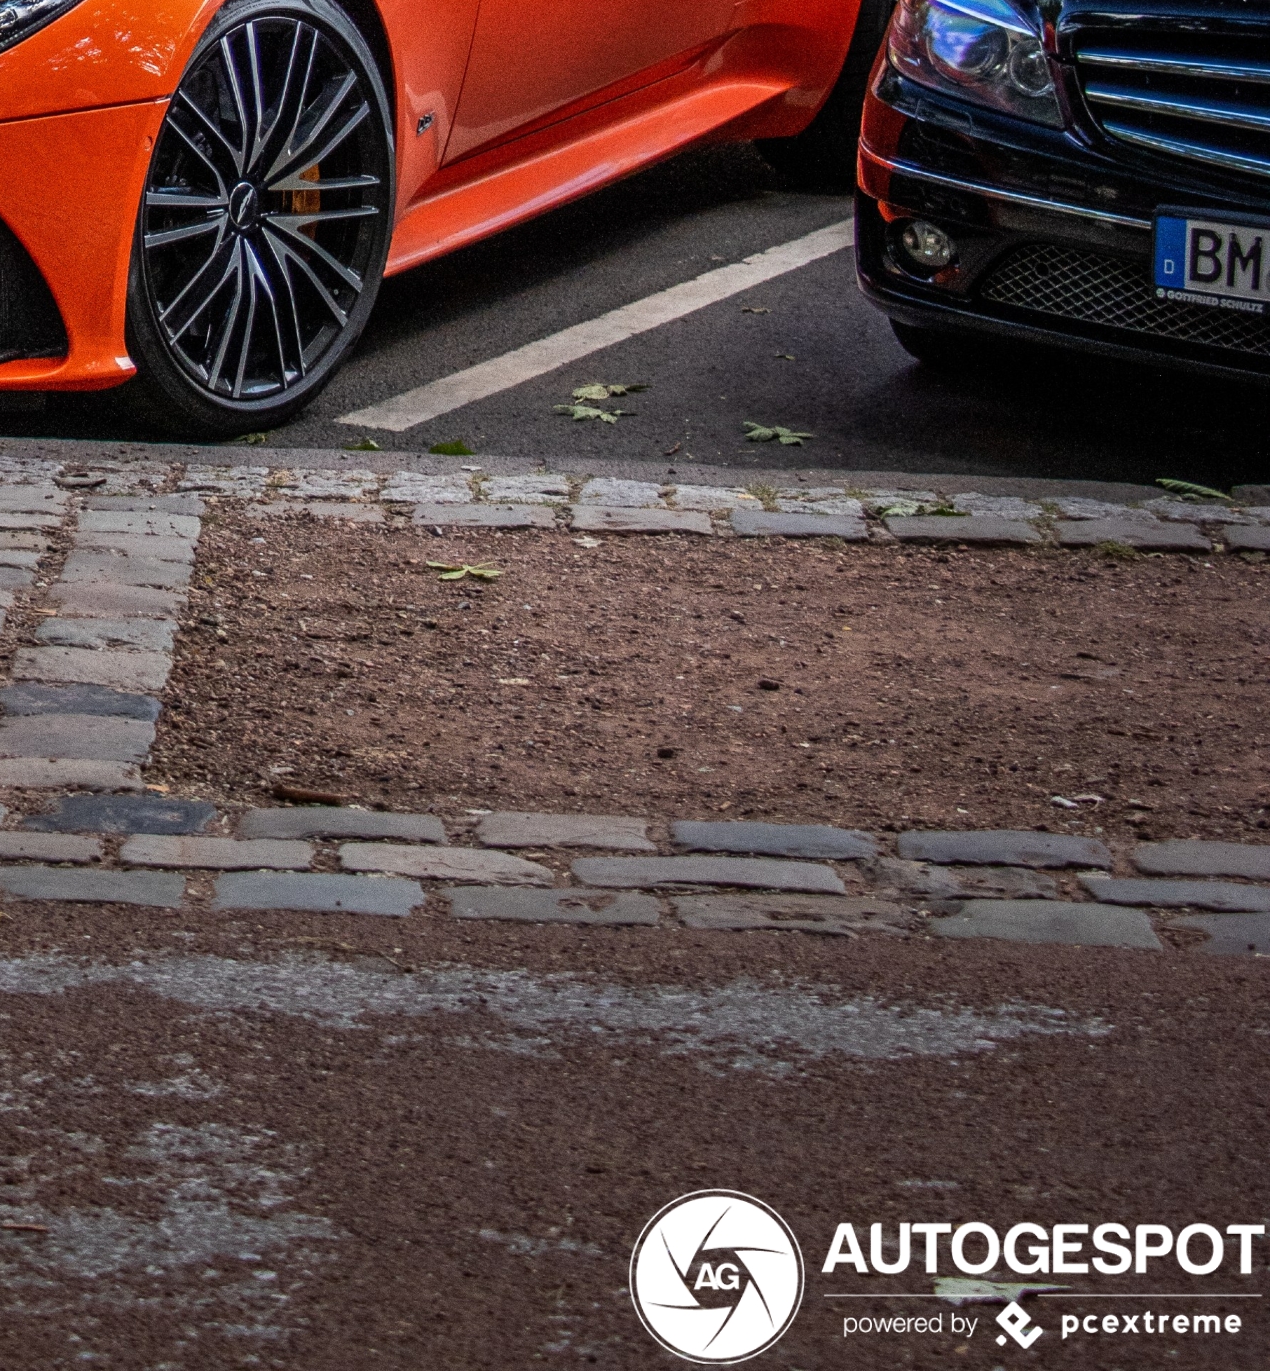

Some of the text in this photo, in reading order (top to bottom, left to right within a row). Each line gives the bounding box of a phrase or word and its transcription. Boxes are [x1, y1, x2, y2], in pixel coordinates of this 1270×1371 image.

[1164, 259, 1175, 275] D
[1189, 227, 1262, 290] BM
[1167, 289, 1264, 314] GOTTFRIED SCHULTZ
